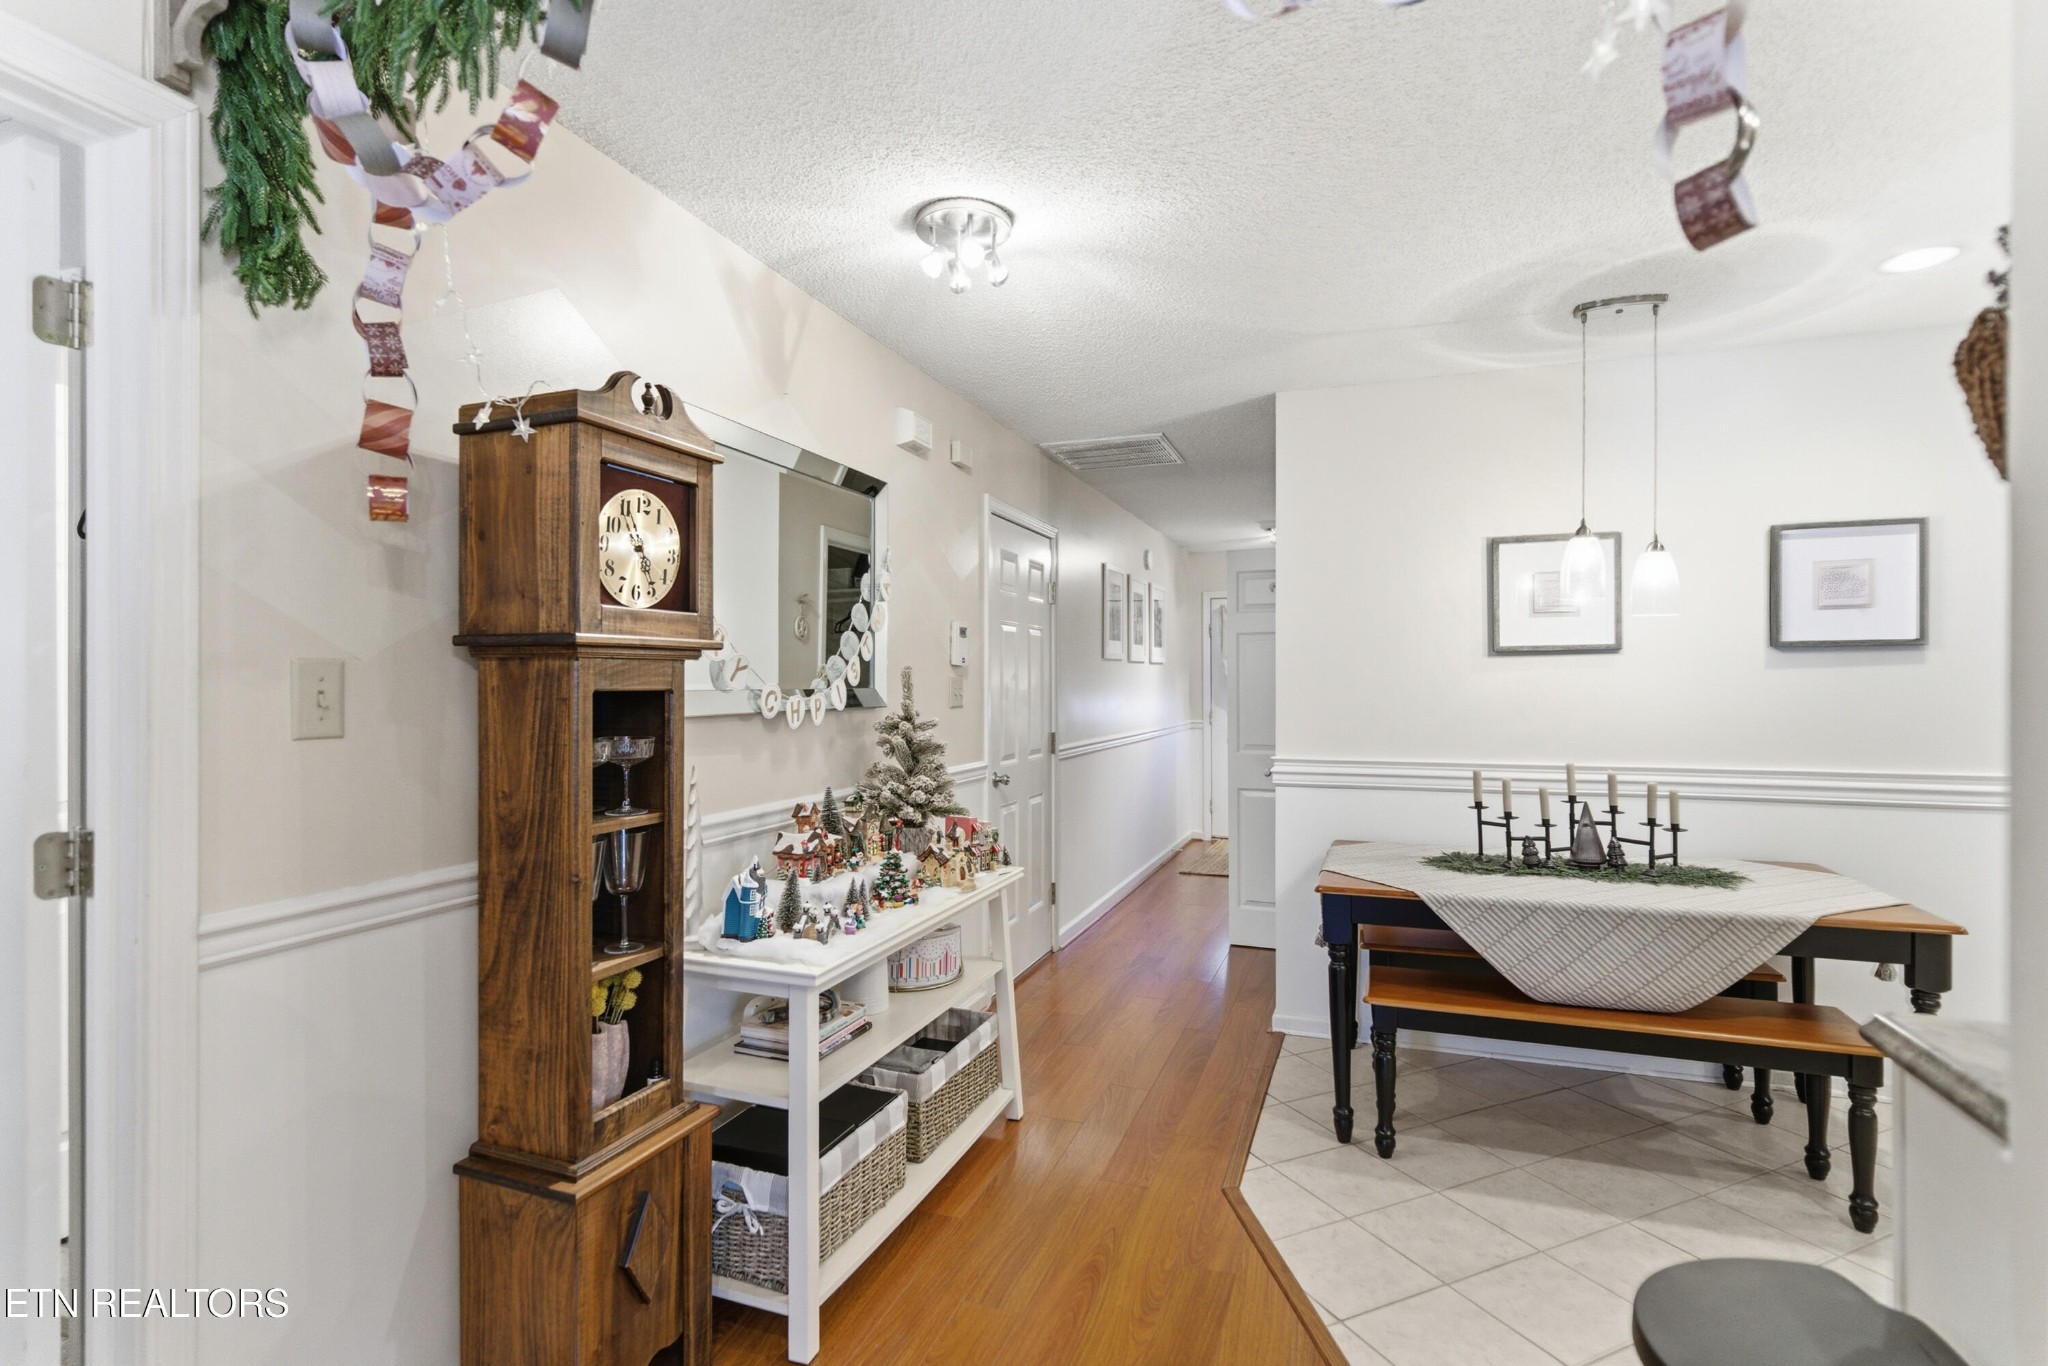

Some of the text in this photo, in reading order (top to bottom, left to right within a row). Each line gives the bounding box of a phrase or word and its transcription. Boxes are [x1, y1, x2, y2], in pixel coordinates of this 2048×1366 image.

[620, 499, 631, 517] 11
[637, 497, 652, 515] 12
[606, 516, 621, 533] 10
[656, 509, 661, 525] 1
[600, 535, 609, 552] 9
[667, 550, 676, 565] 3
[604, 559, 615, 577] 8
[618, 576, 627, 593] 7
[660, 569, 667, 585] 4
[631, 585, 641, 601] 6
